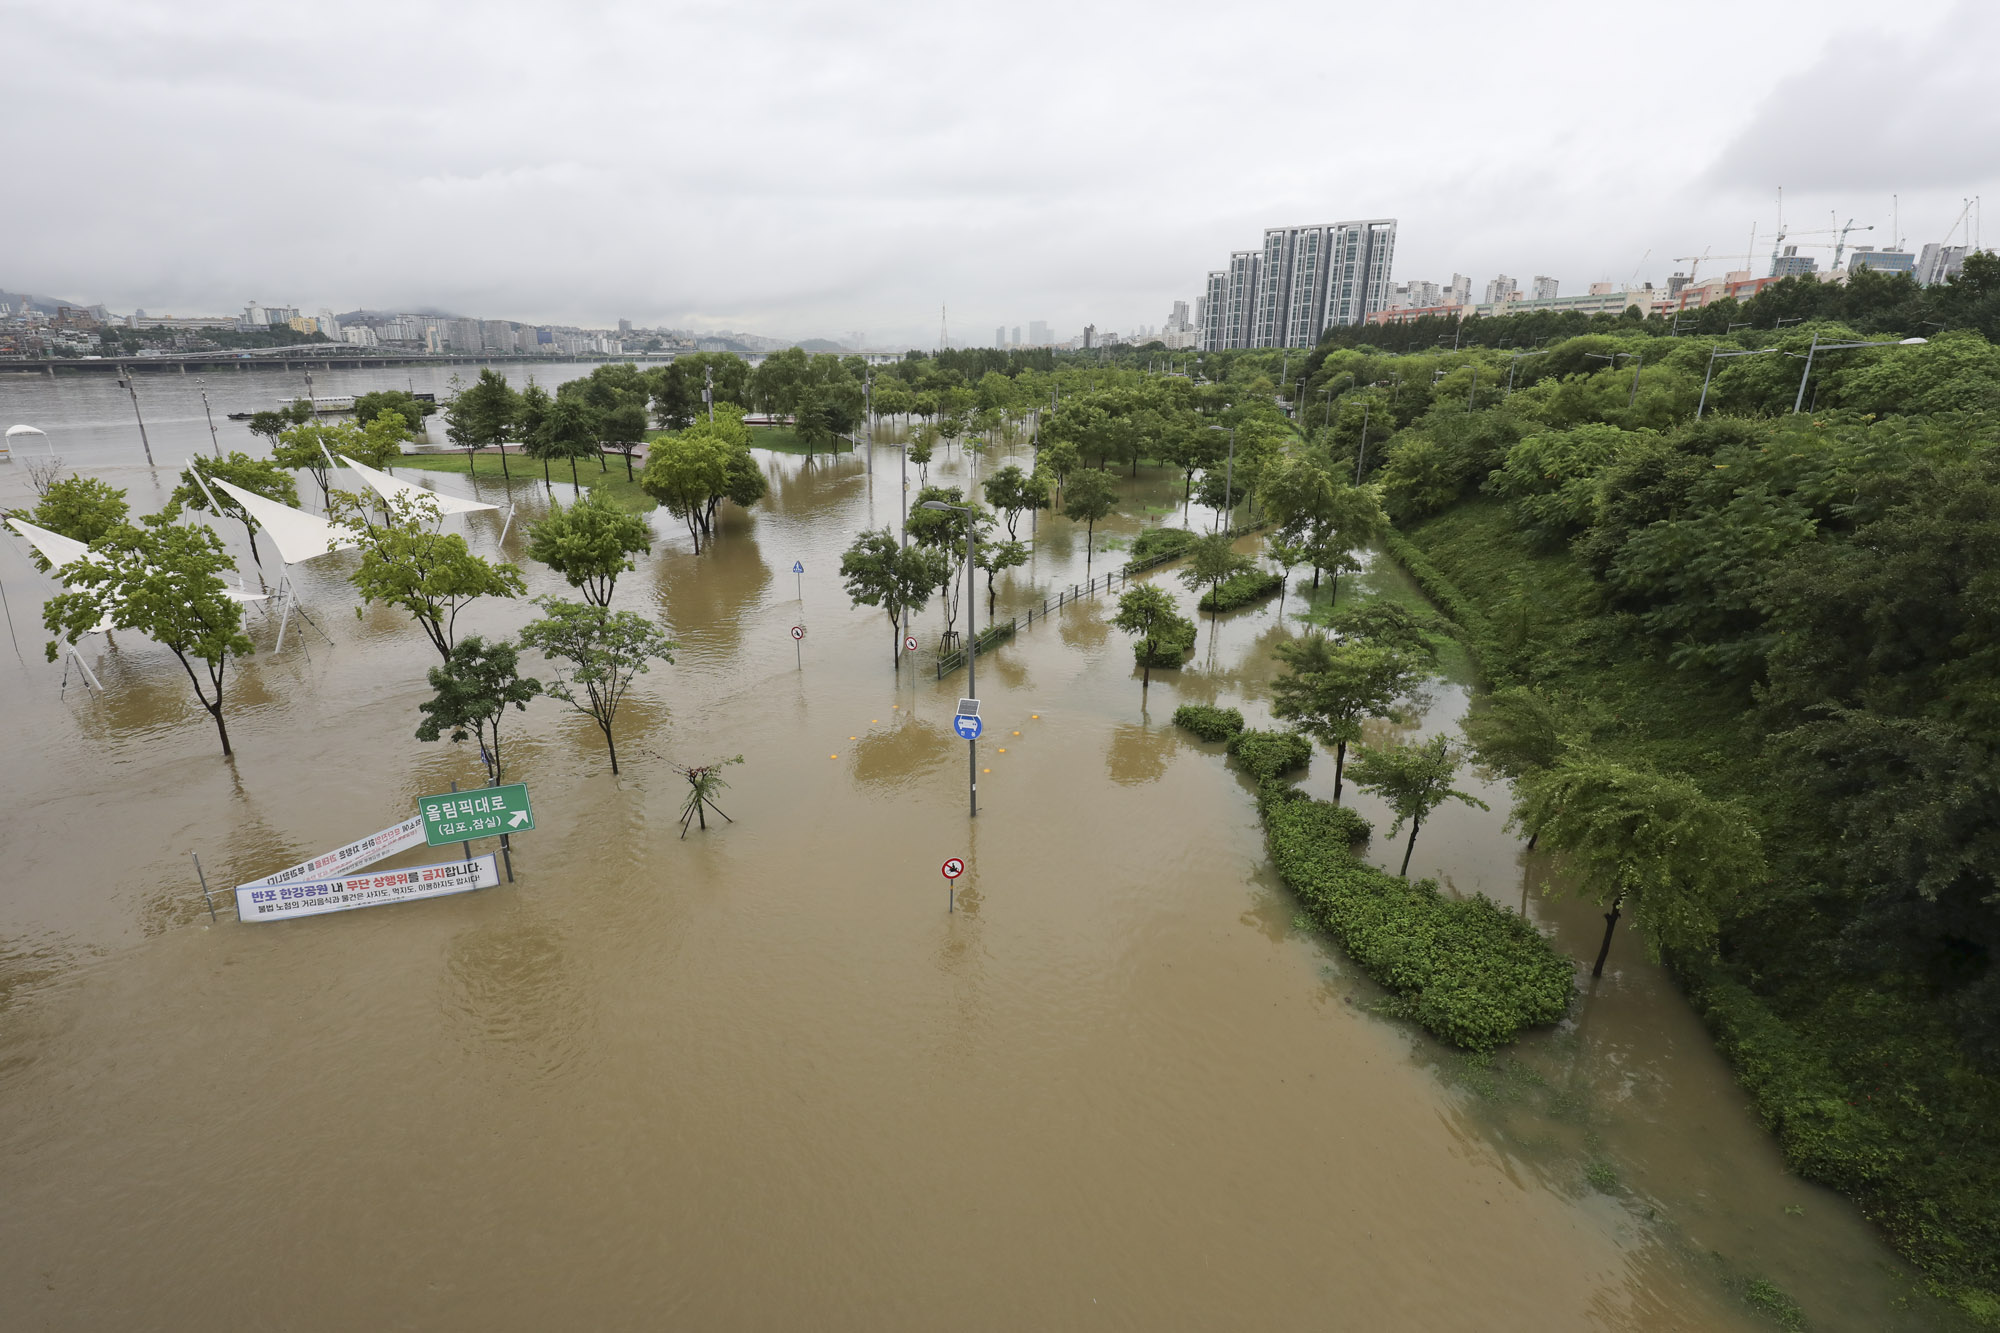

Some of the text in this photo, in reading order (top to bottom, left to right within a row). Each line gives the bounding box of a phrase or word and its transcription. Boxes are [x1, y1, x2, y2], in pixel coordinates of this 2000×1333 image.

[425, 795, 507, 822] 올림픽대로
[438, 815, 501, 836] (김포,잠실)
[251, 862, 483, 904] 반포 한강공원 내 무단 상행위를 금지합니다.
[258, 904, 274, 913] 불법
[275, 901, 300, 911] 노점의
[301, 896, 340, 908] 거리음식과
[341, 892, 364, 902] 물건은
[366, 889, 391, 899] 사지도,
[392, 885, 416, 894] 먹지도,
[418, 878, 455, 891] 이용하지도
